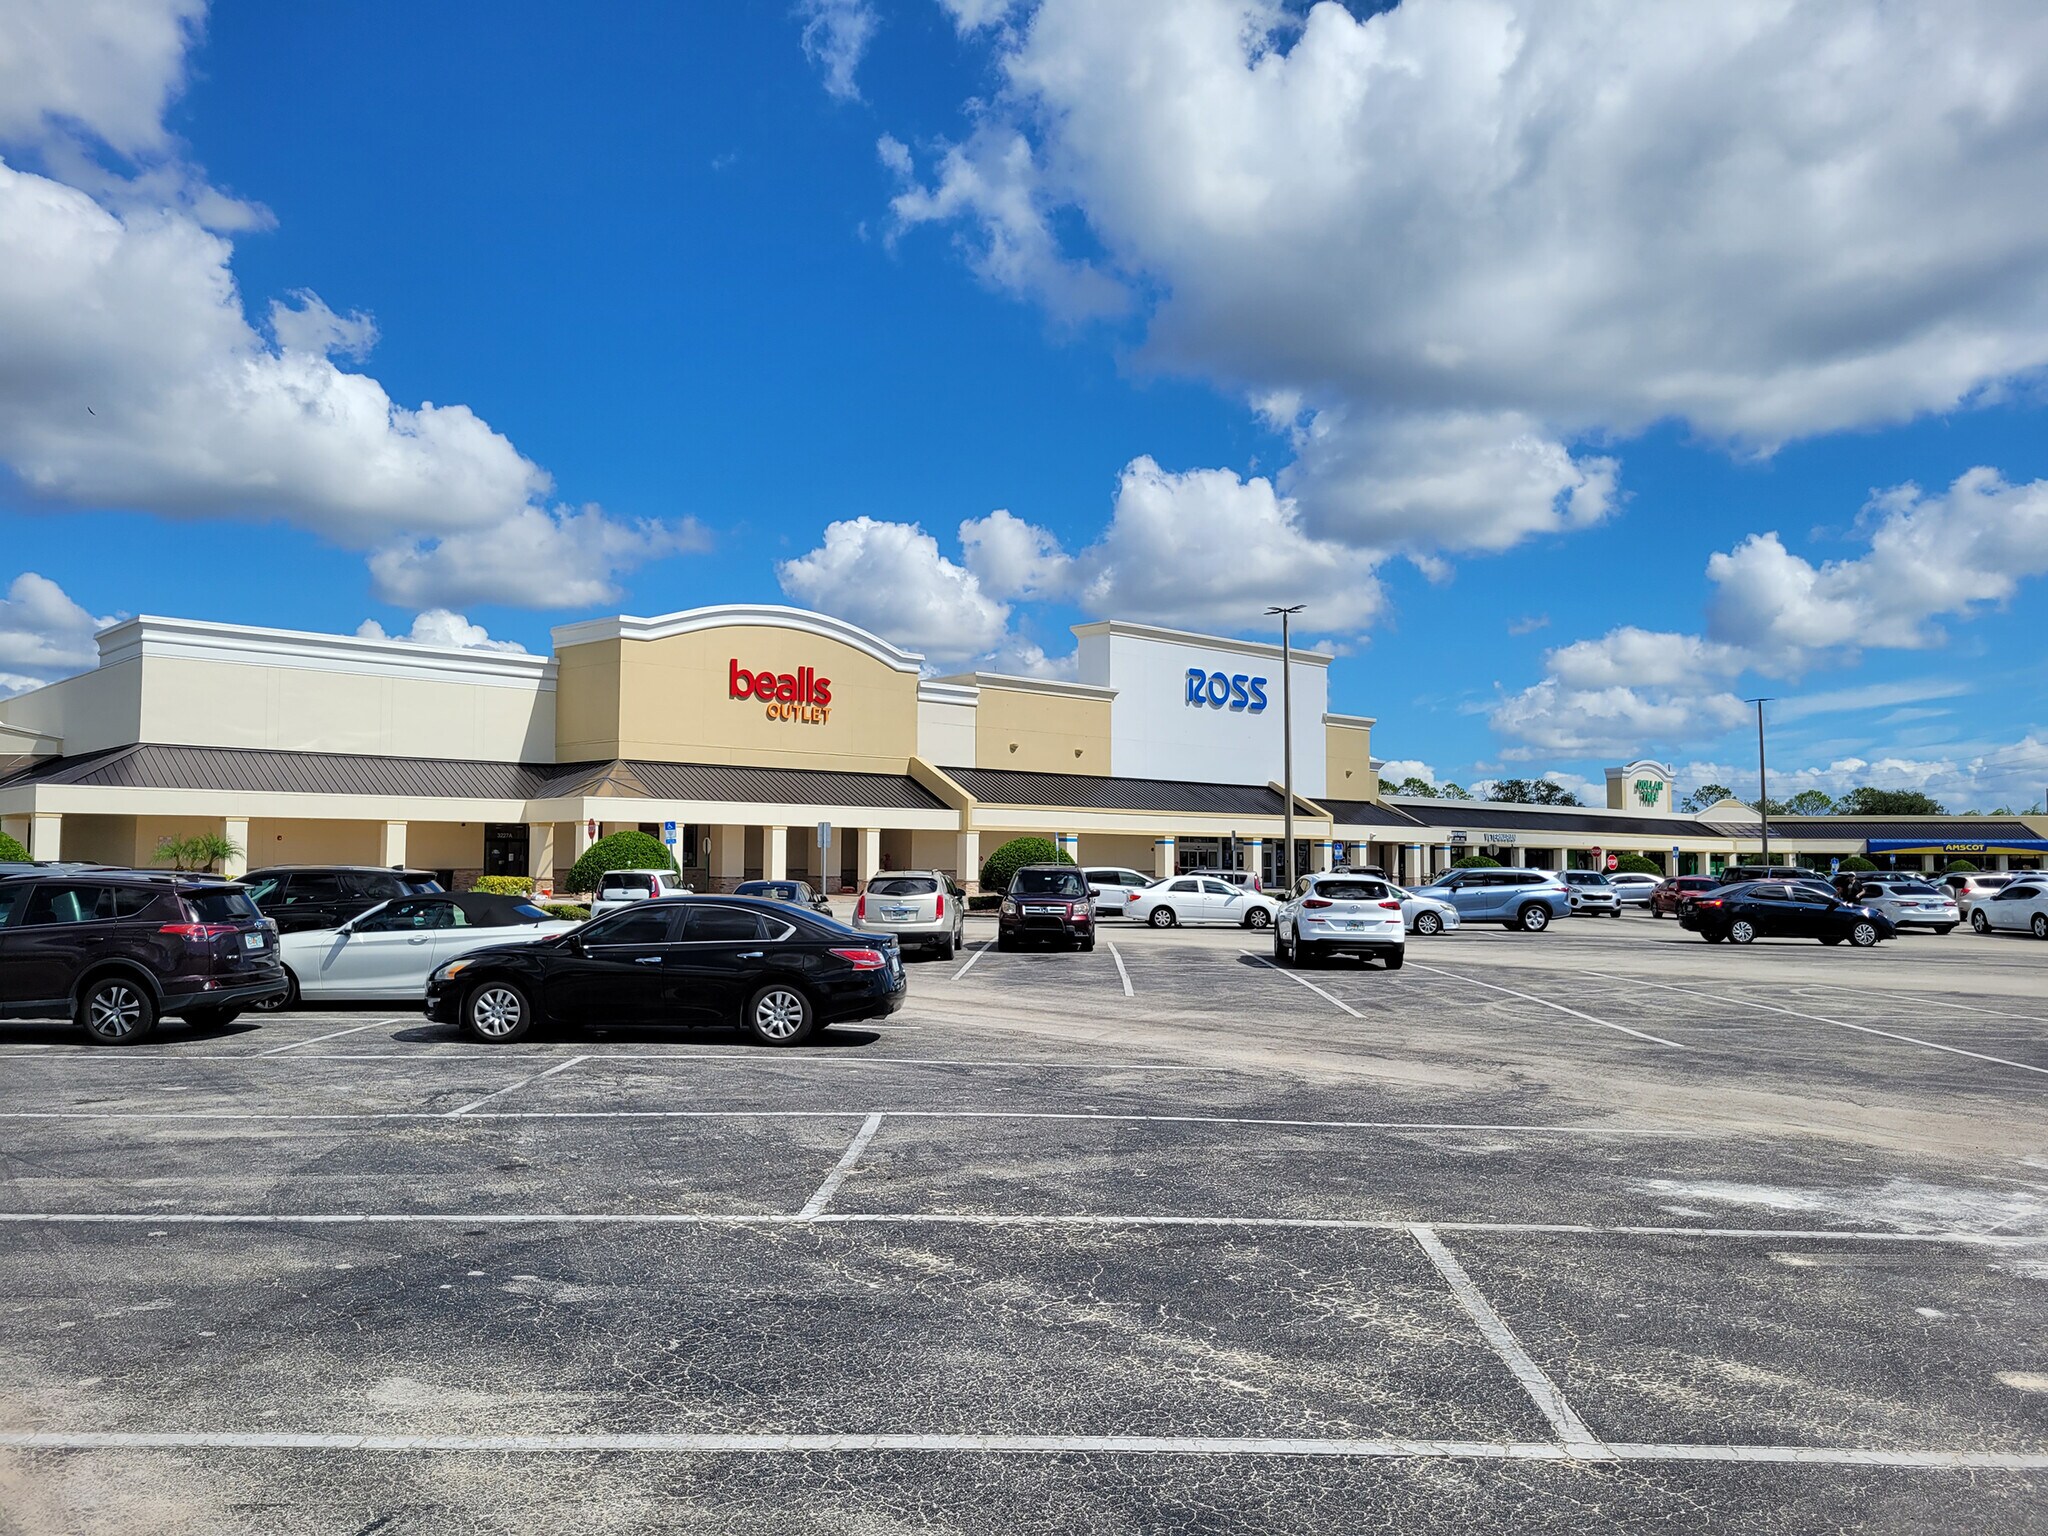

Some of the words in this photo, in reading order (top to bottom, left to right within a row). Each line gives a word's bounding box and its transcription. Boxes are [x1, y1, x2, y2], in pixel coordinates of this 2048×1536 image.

[729, 658, 832, 706] bealls
[1187, 667, 1268, 711] ROSS
[766, 702, 832, 724] OUTLET
[1637, 779, 1663, 791] DOLLAR
[1642, 792, 1659, 803] TREE
[1945, 844, 1985, 852] AMSCOT
